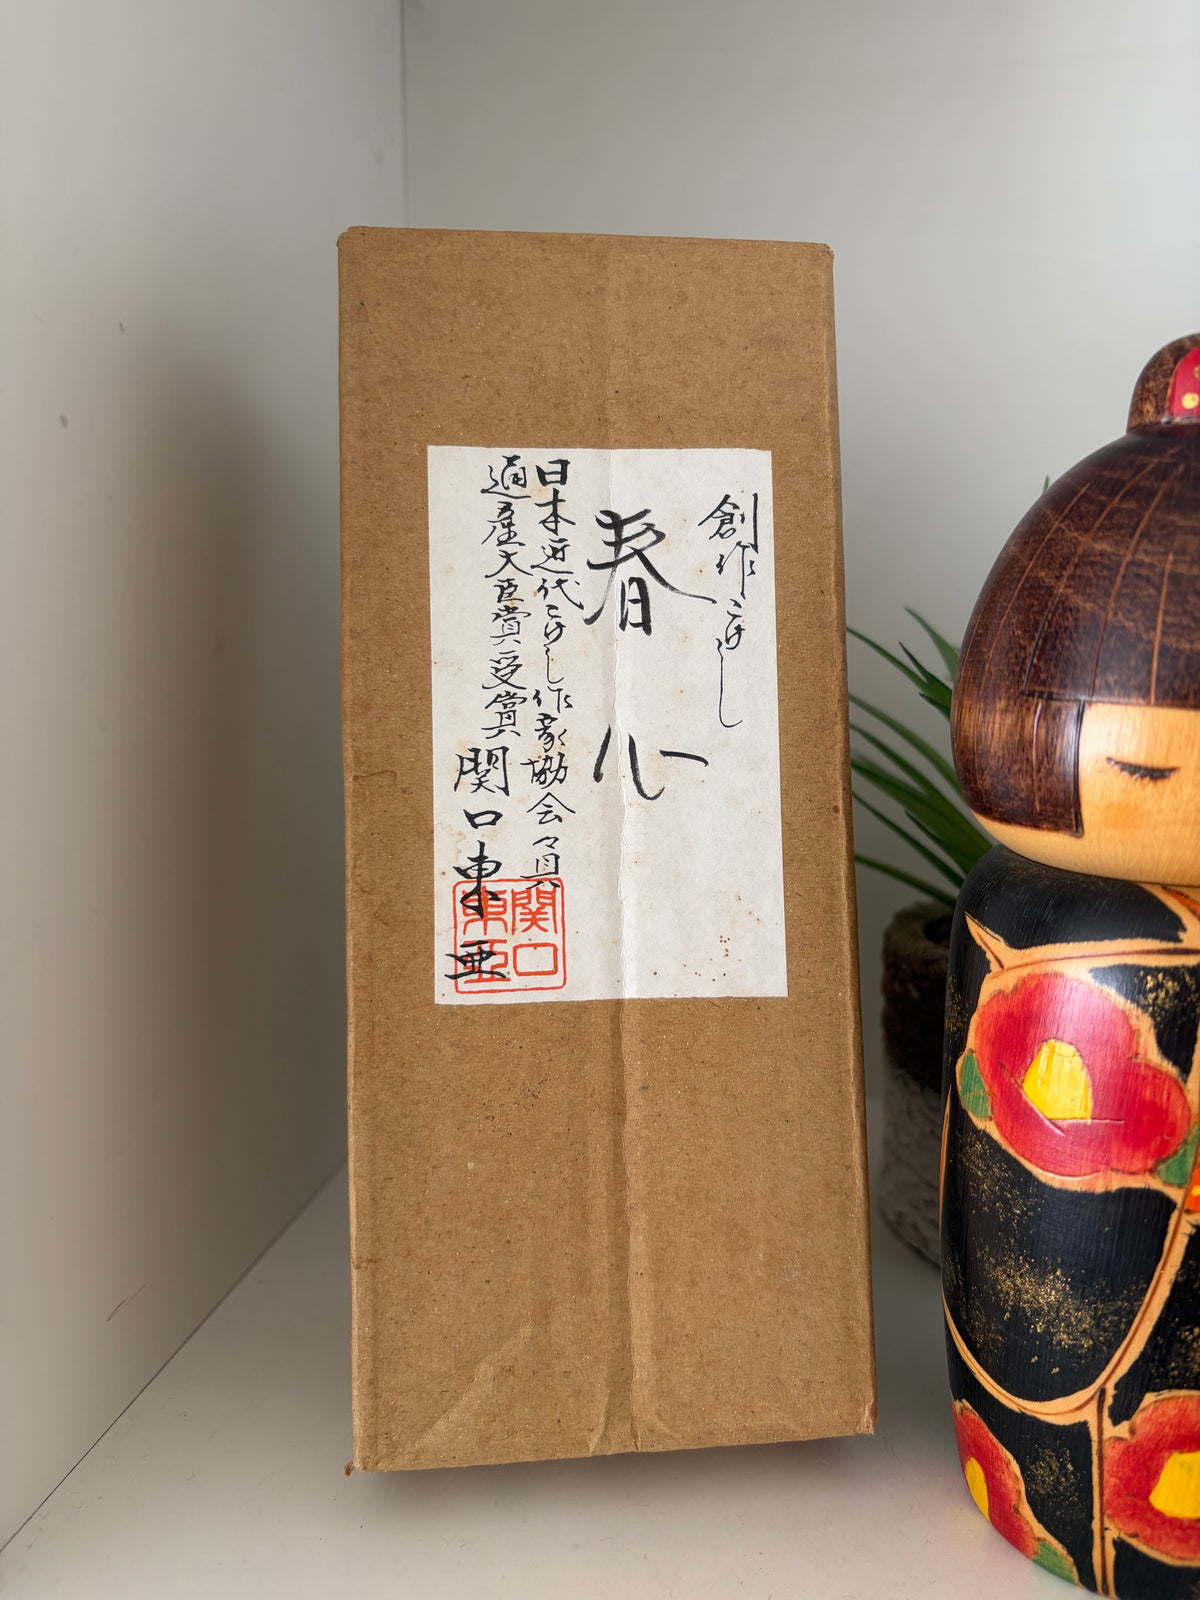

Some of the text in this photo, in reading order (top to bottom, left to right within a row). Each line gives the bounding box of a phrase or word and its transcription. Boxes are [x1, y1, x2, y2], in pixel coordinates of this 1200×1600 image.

[583, 508, 718, 801] 春心
[697, 492, 759, 728] 創作こけし
